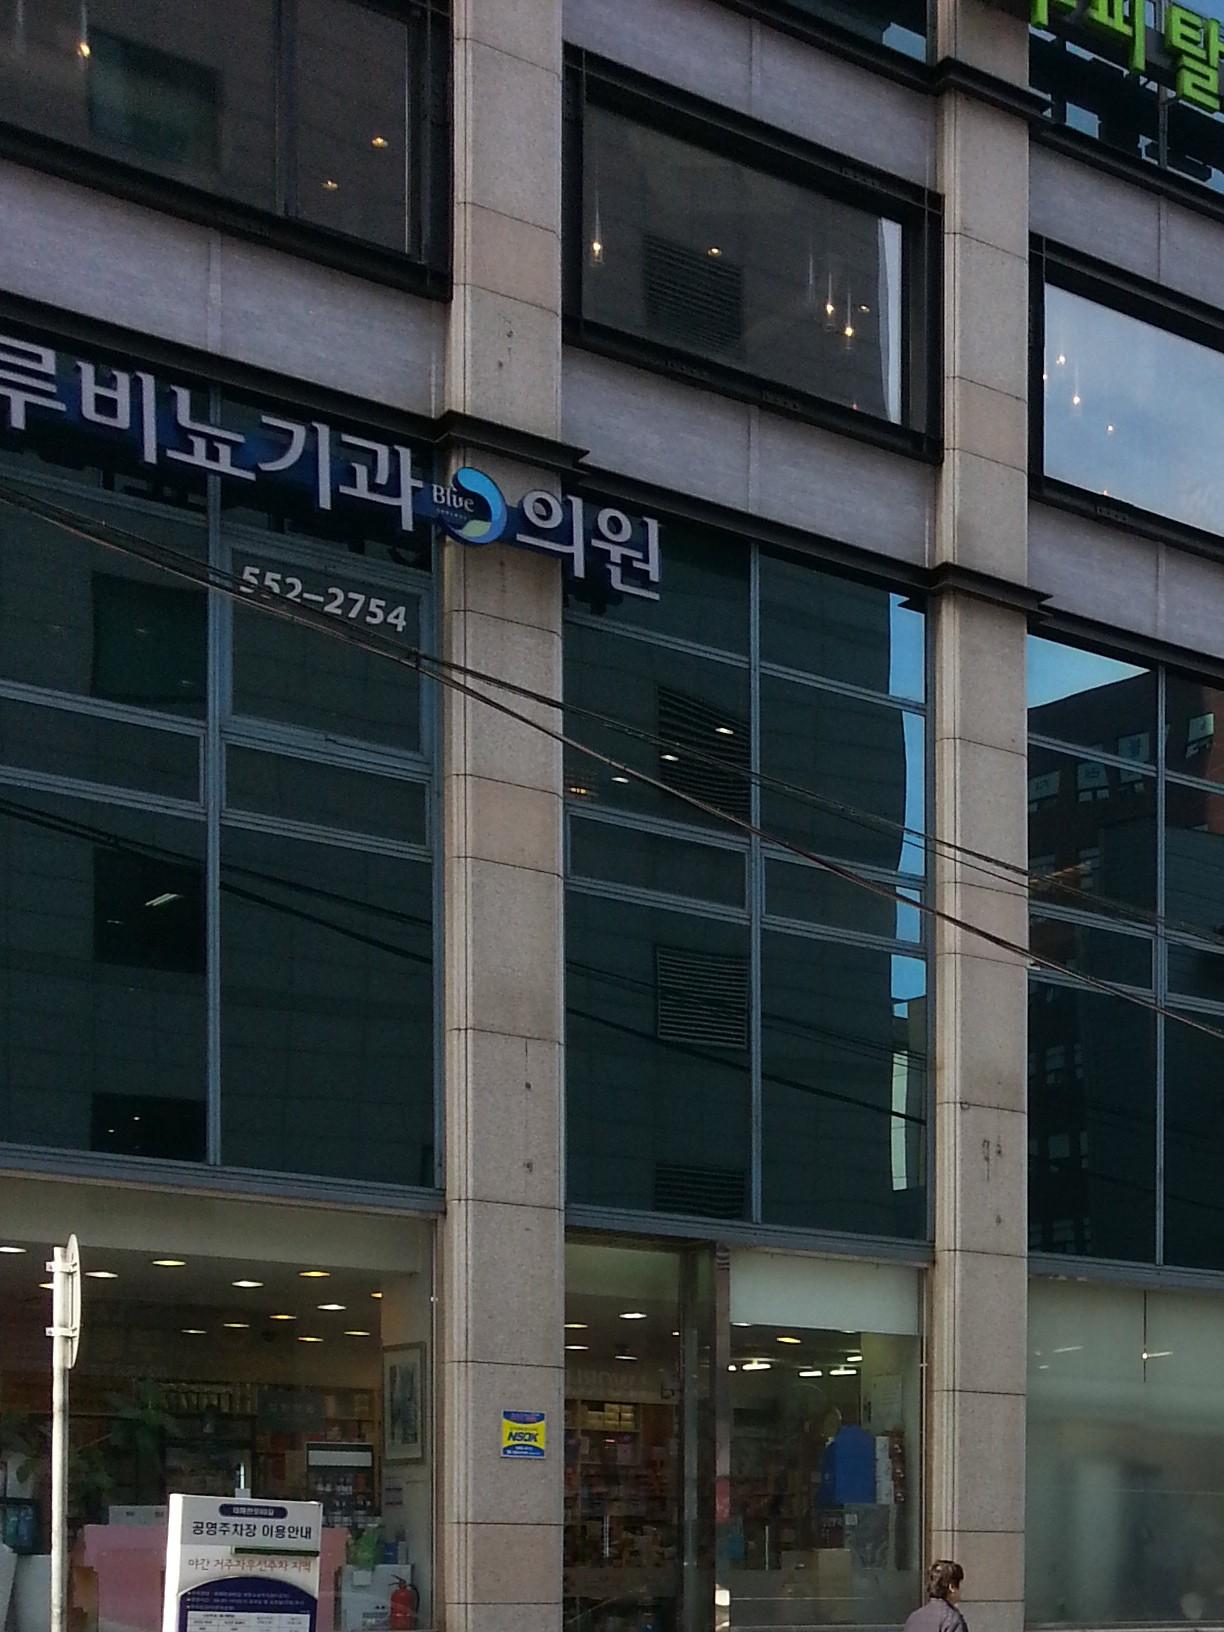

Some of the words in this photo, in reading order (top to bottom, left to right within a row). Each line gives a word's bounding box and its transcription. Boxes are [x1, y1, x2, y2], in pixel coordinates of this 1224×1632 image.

[432, 483, 475, 513] Blue
[516, 488, 661, 601] 의원
[239, 565, 408, 633] 552-2754
[192, 1521, 257, 1538] 공영주차장
[262, 1524, 312, 1540] 이용안내
